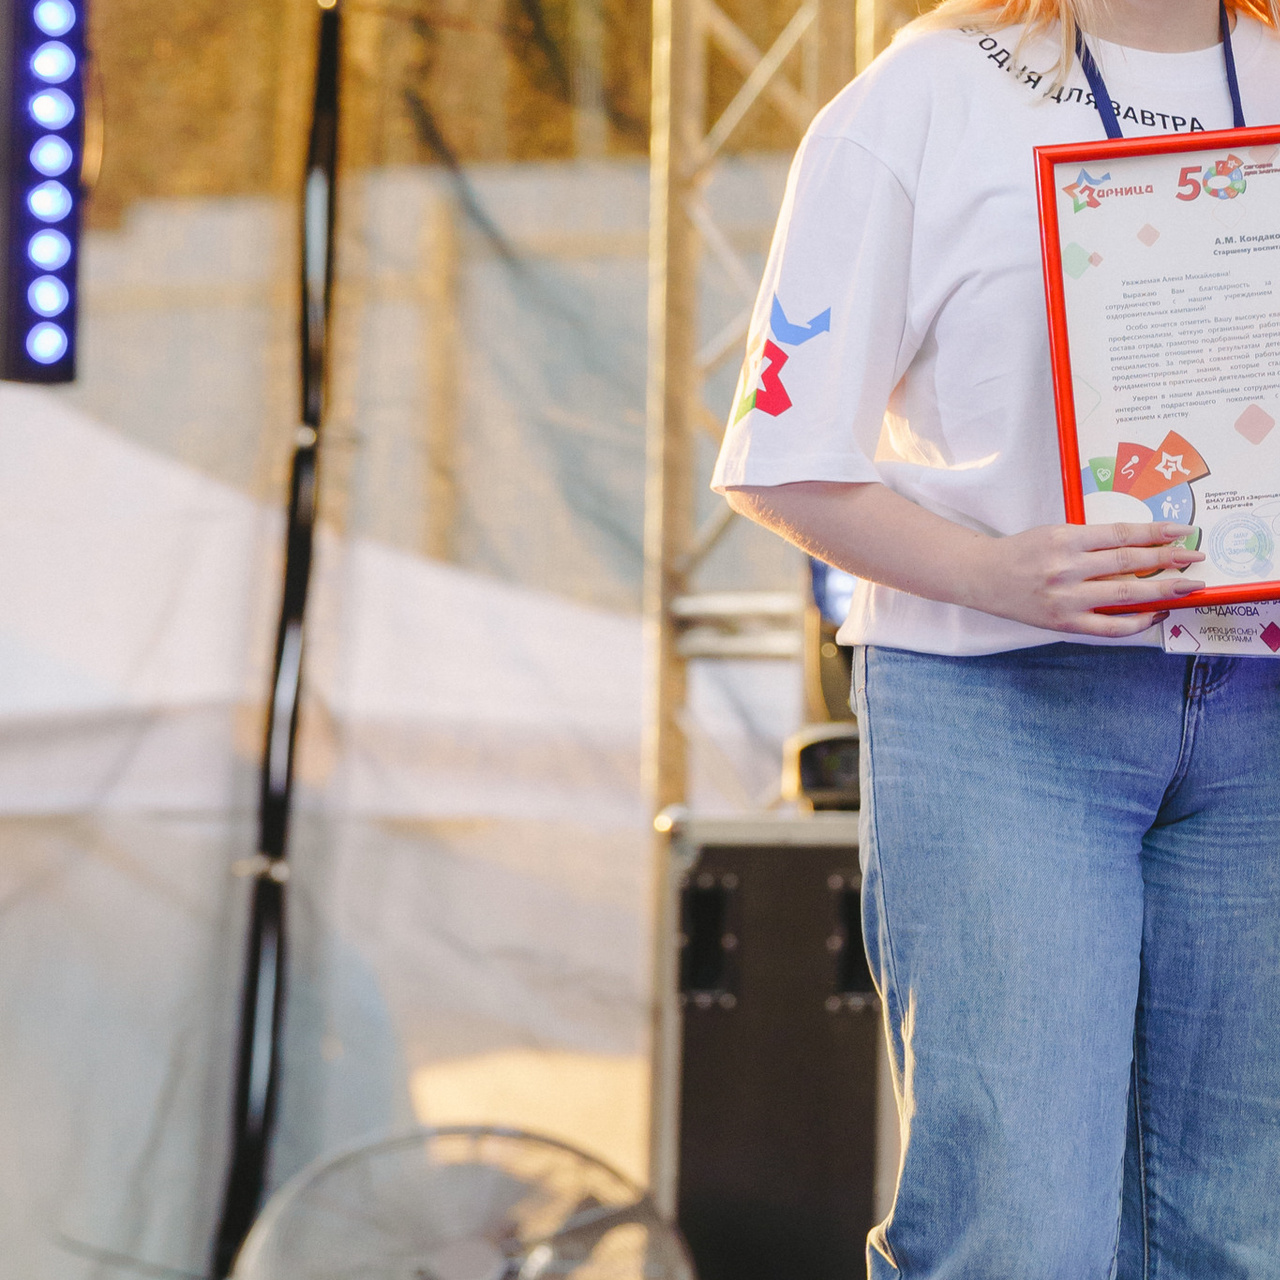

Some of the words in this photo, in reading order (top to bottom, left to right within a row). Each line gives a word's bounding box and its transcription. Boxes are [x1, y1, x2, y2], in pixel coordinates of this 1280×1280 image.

[1111, 100, 1206, 133] ЗАВТРА
[1215, 236, 1237, 244] А.М.
[1213, 247, 1251, 256] Старшему
[1121, 277, 1160, 285] Уважаемая
[1185, 270, 1231, 279] Михайловна!
[1122, 290, 1157, 299] Выражаю
[1198, 282, 1250, 292] благодарность
[1105, 301, 1161, 311] сотрудничество
[1224, 290, 1273, 300] учреждением
[1106, 310, 1168, 320] оздоровительных
[1170, 305, 1207, 314] кампаний!
[1214, 315, 1233, 323] Вашу
[1235, 313, 1266, 321] высокую
[1108, 332, 1173, 342] профессионализм,
[1207, 324, 1255, 333] организацию
[1201, 333, 1250, 343] подобранный
[1110, 353, 1160, 361] внимательное
[1217, 343, 1260, 352] результатам
[1178, 358, 1205, 366] период
[1209, 353, 1250, 362] совместной
[1112, 370, 1188, 381] продемонстрировали
[1230, 362, 1260, 370] которые
[1113, 382, 1161, 391] фундаментом
[1168, 376, 1217, 386] практической
[1218, 372, 1265, 381] деятельности
[1132, 394, 1158, 402] Уверен
[1196, 386, 1240, 396] дальнейшем
[1115, 405, 1151, 413] интересов
[1161, 399, 1216, 409] подрастающего
[1115, 414, 1156, 423] уважением
[1204, 490, 1238, 498] Директор
[1194, 605, 1260, 617] КОНДАКОВА
